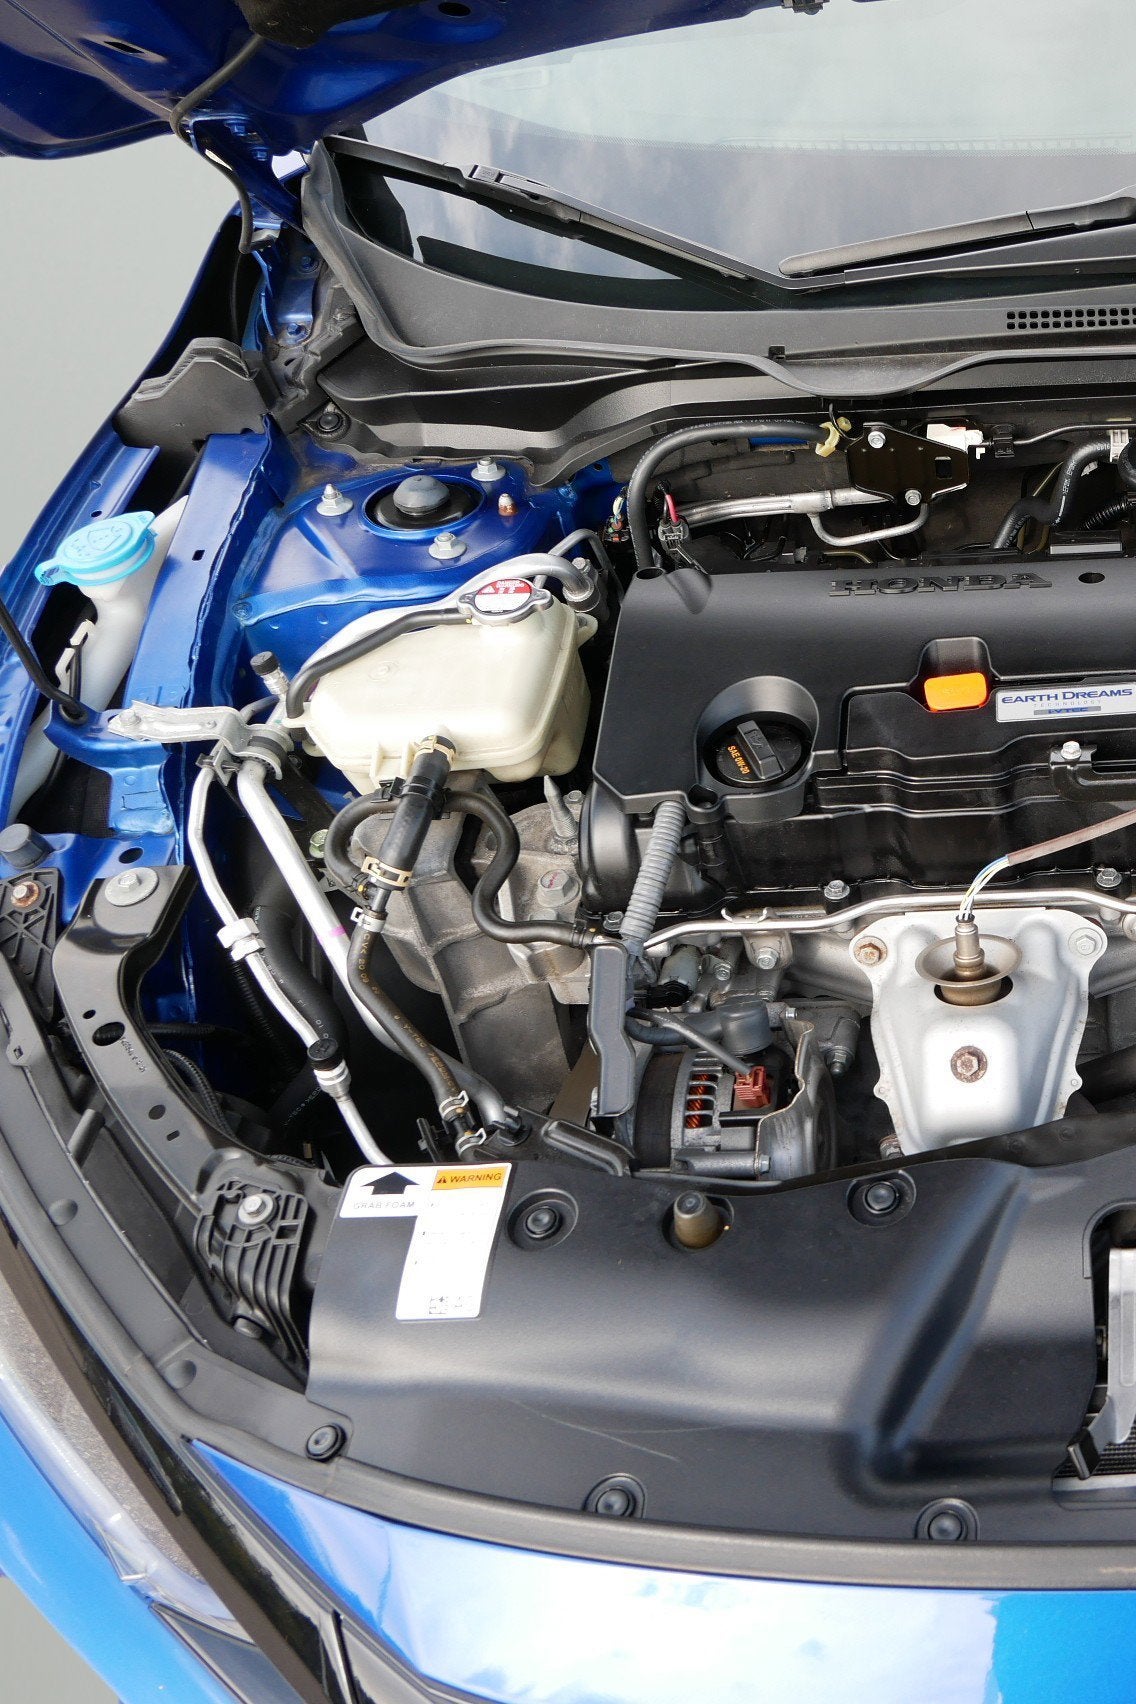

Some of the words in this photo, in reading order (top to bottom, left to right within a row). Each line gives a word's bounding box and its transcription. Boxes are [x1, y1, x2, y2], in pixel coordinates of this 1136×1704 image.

[829, 573, 1053, 596] HONDA
[1001, 693, 1058, 704] EARTH
[1062, 688, 1133, 700] DREAMS
[1033, 700, 1102, 708] TECHNOLOGY
[727, 745, 740, 759] SAE
[735, 756, 750, 773] 0W-20
[449, 1172, 502, 1183] WARNING
[385, 1201, 415, 1209] FOAM
